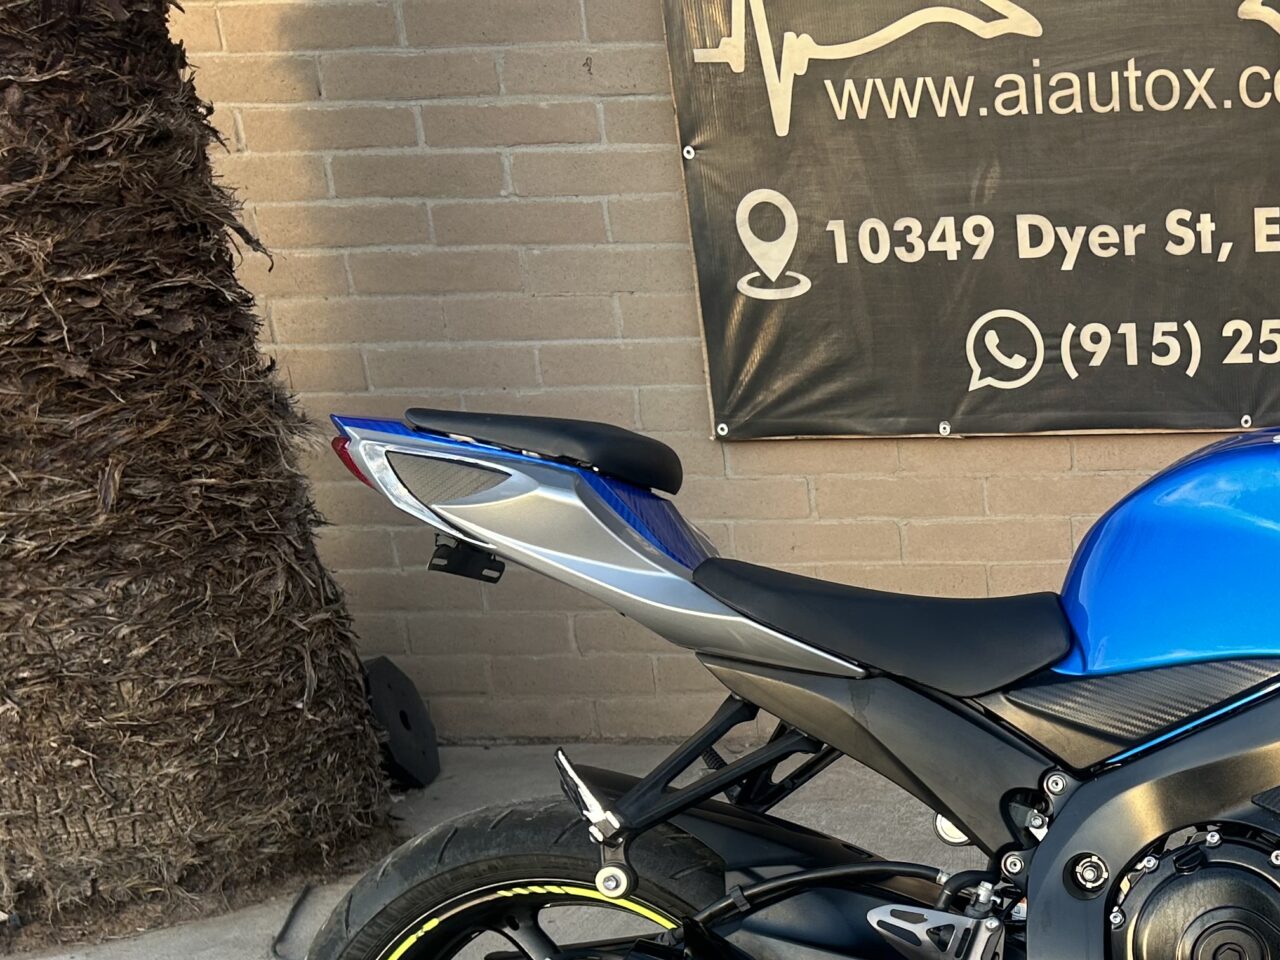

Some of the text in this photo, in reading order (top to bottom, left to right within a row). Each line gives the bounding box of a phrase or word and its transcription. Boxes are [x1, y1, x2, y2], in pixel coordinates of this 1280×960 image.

[825, 214, 995, 264] 10349
[1016, 213, 1146, 271] Dyer
[1165, 208, 1234, 263] St,
[1060, 319, 1202, 380] (915)
